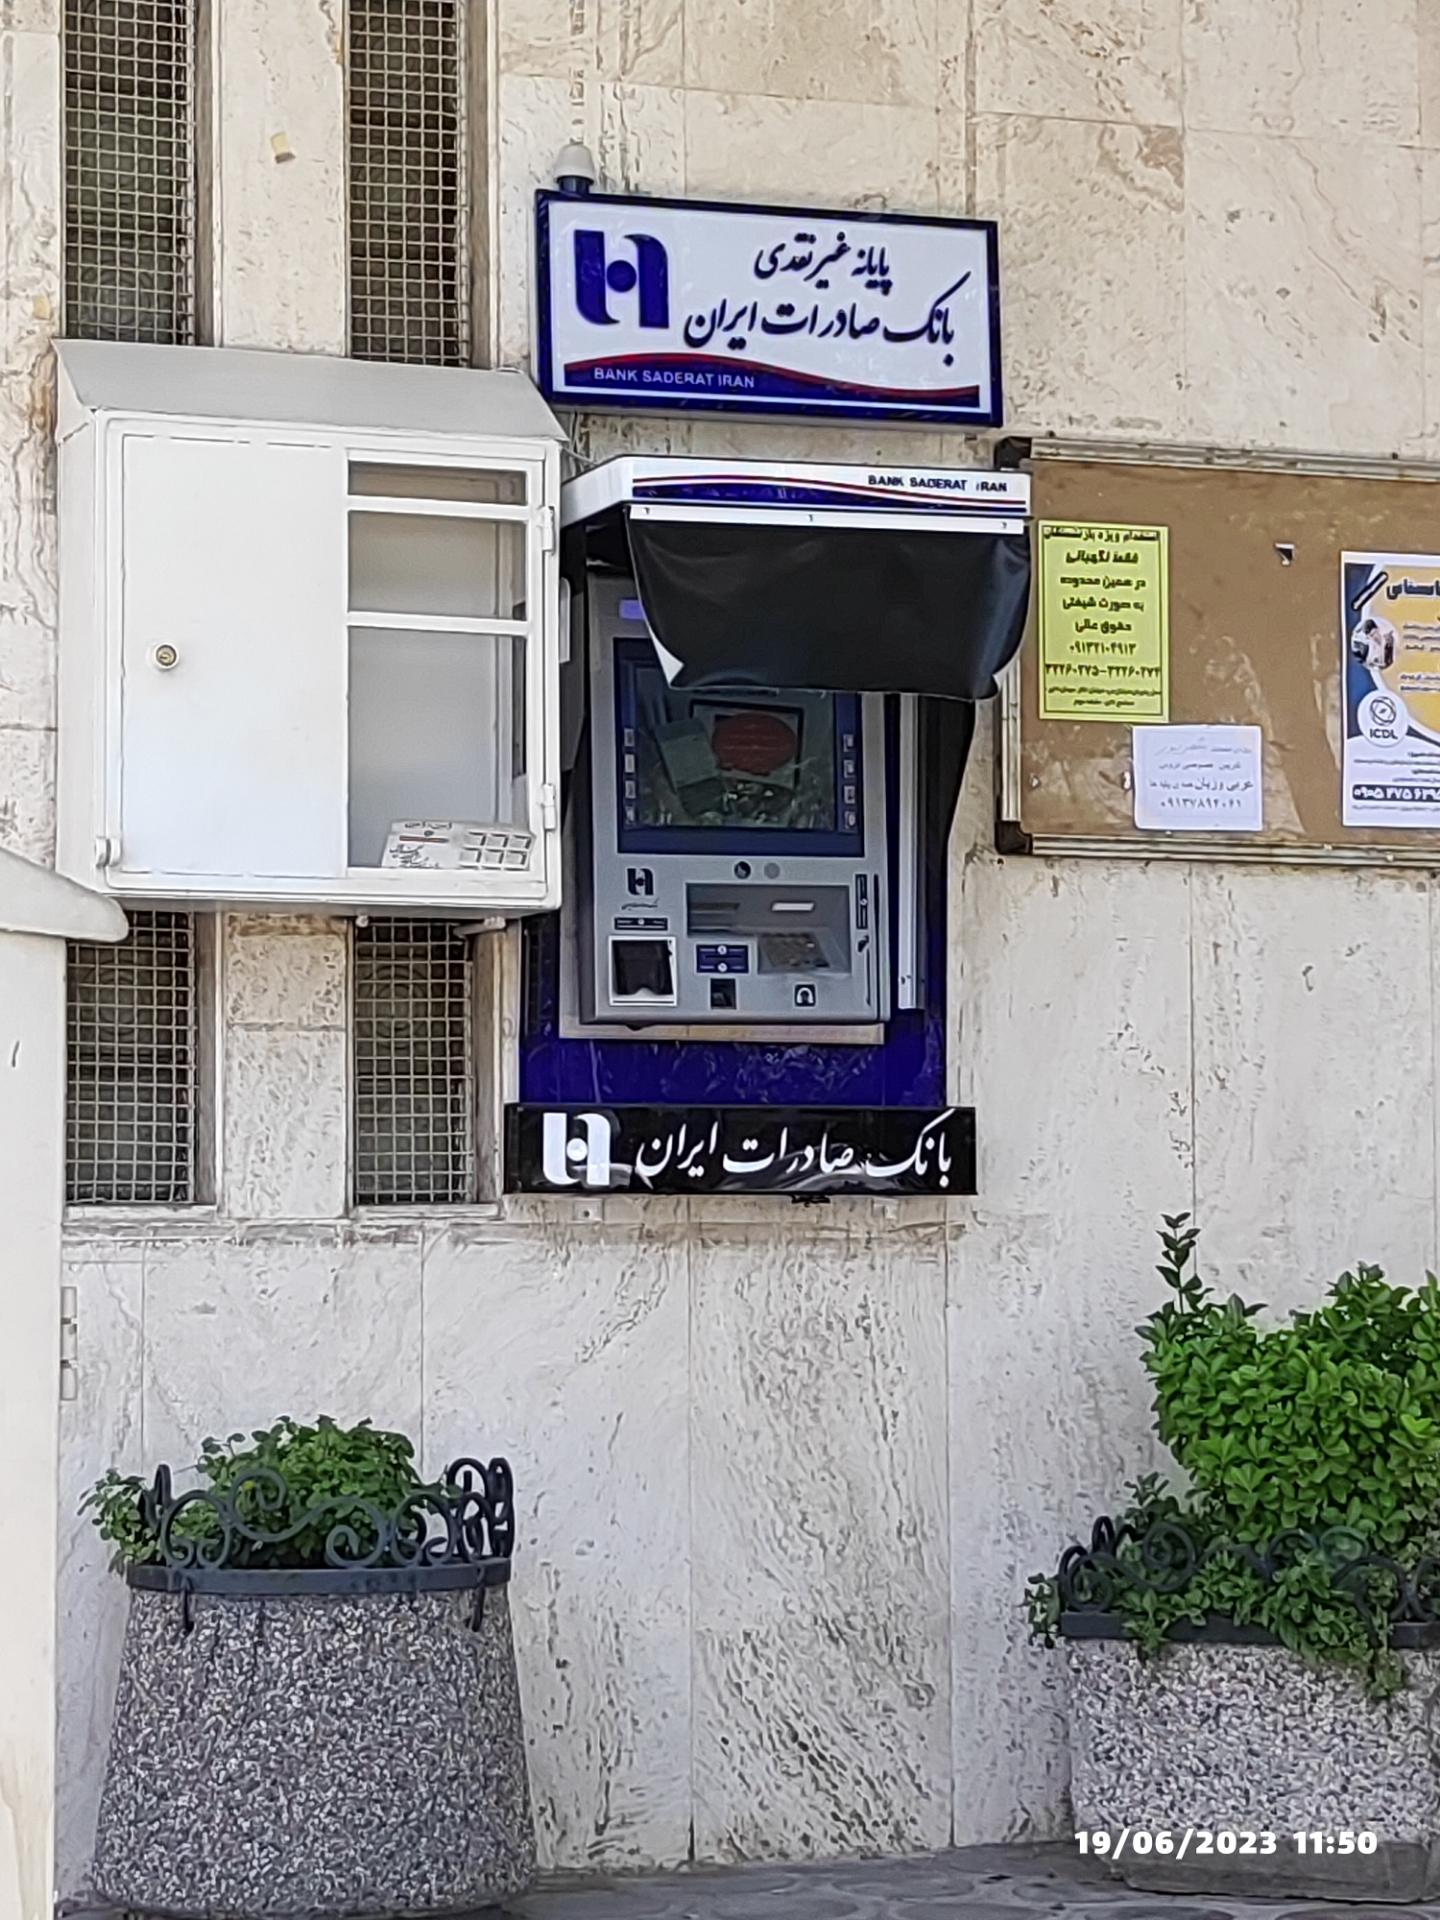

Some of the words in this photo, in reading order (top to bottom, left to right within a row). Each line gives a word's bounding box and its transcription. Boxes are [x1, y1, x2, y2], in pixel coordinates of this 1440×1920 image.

[851, 245, 892, 296] پایانه
[684, 298, 758, 351] ایران
[761, 303, 880, 342] صادرات
[884, 271, 971, 366] بانک
[594, 367, 638, 383] BANK
[642, 369, 714, 387] SADERAT
[718, 373, 755, 389] IRAN
[868, 475, 905, 487] BANK
[910, 477, 968, 491] SADERAT
[1066, 550, 1111, 565] نگهبانی
[1134, 579, 1147, 591] در
[1075, 618, 1099, 633] عالی
[1369, 728, 1399, 740] ICDL
[635, 1120, 718, 1179] ایران
[722, 1126, 854, 1175] صادرات
[865, 1107, 955, 1188] بانک
